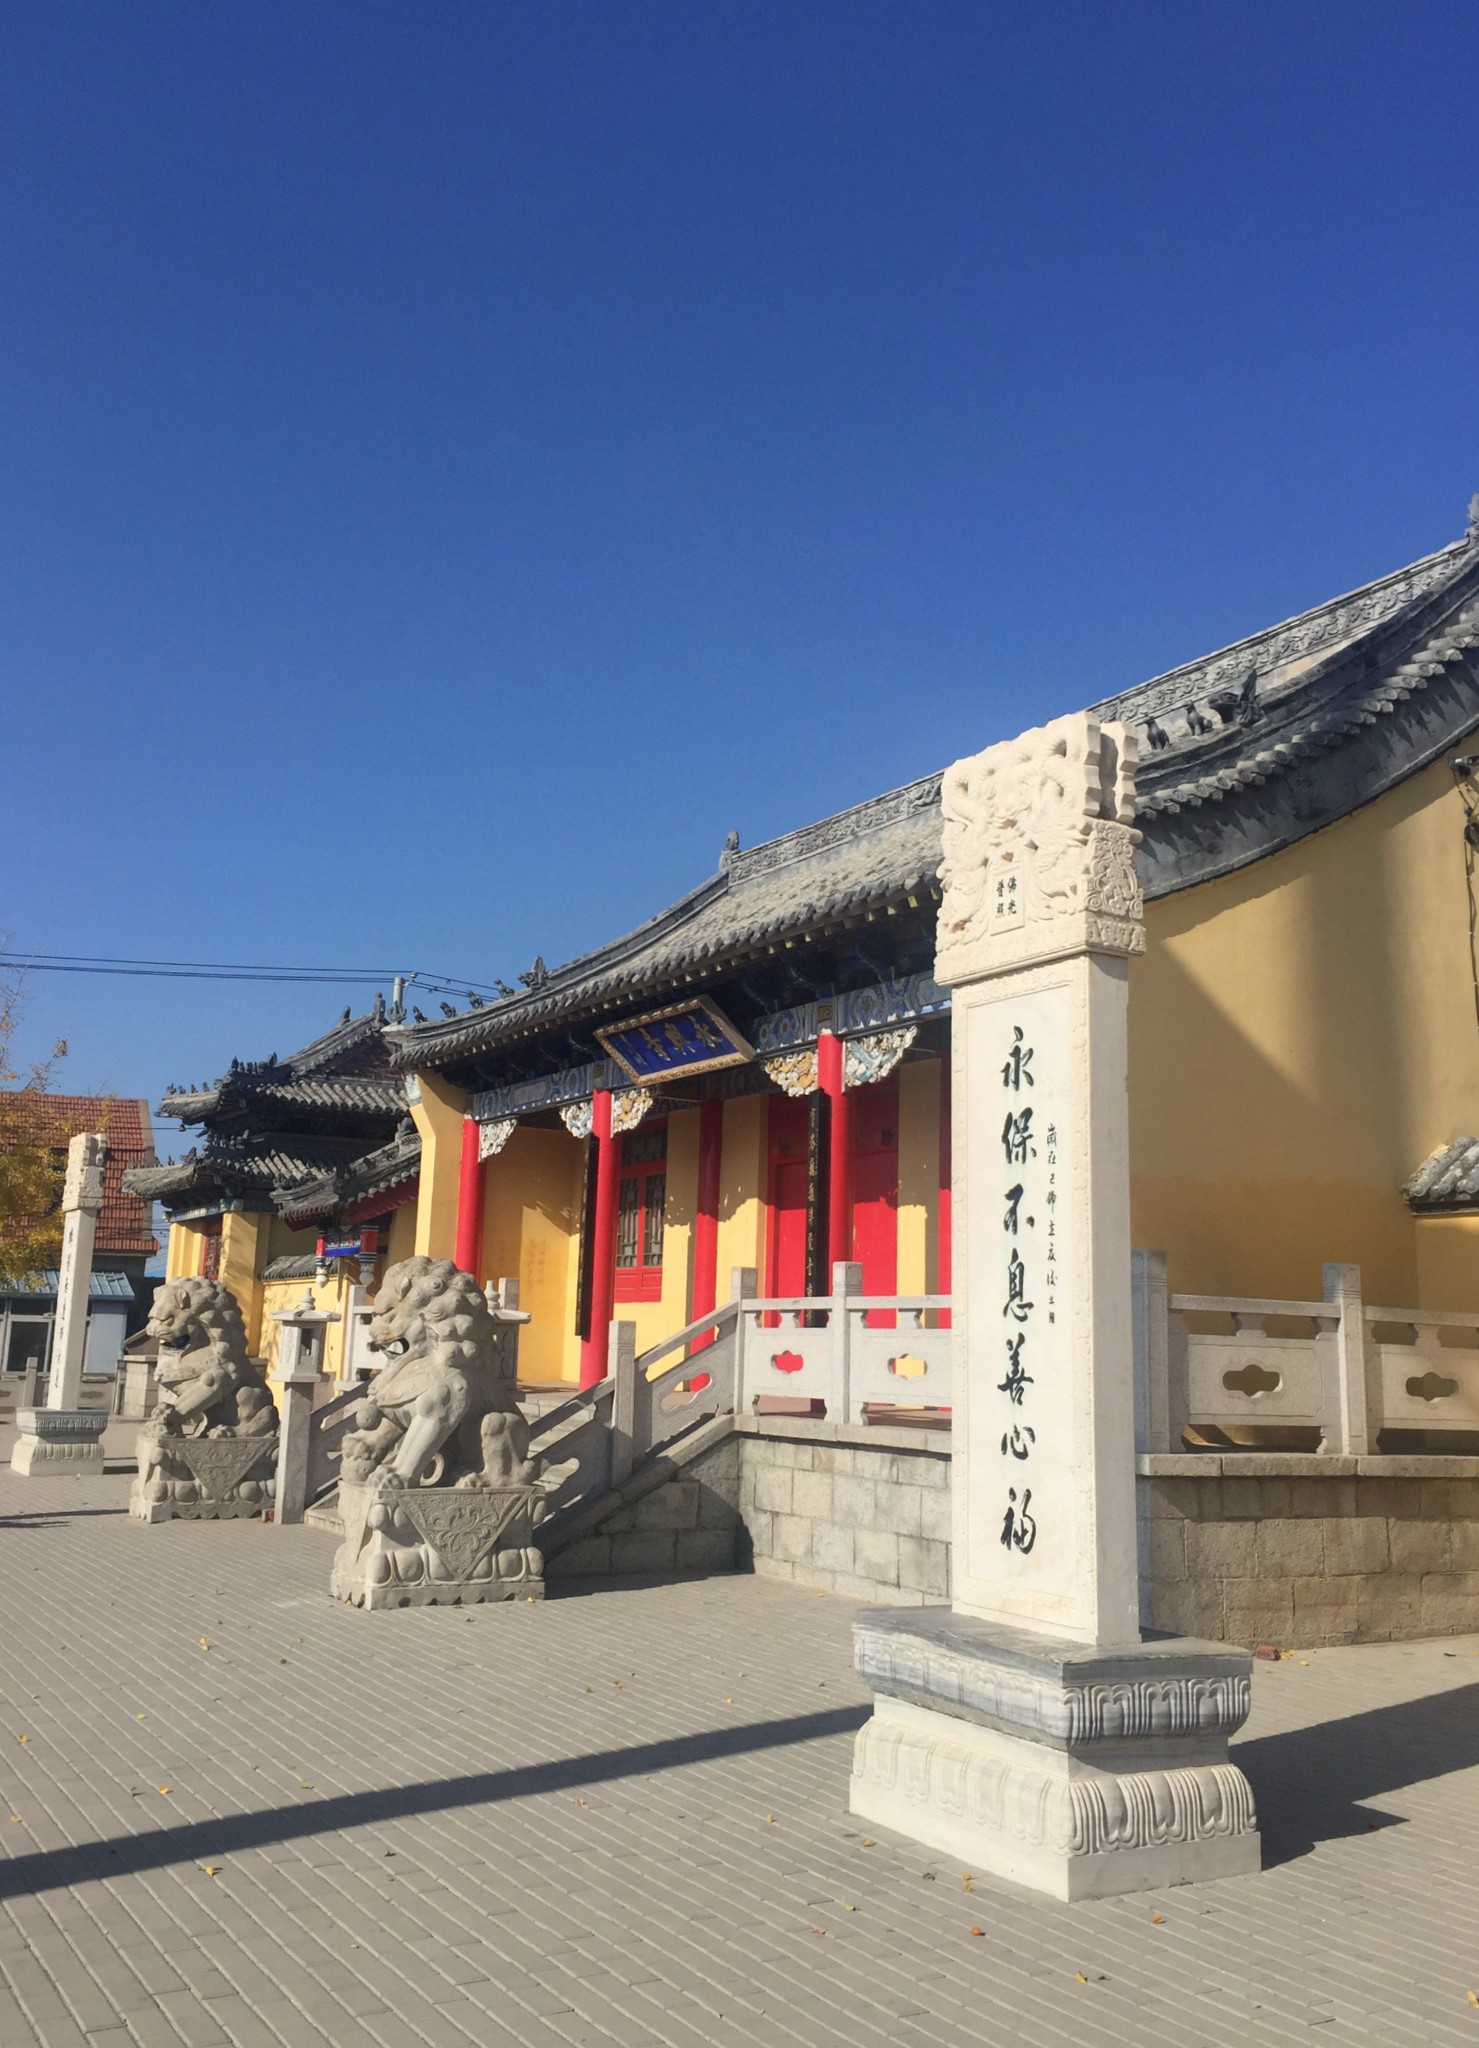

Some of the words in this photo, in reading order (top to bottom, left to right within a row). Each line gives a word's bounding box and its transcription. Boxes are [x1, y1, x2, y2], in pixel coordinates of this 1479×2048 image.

[996, 1025, 1037, 1555] 永保不息善心福
